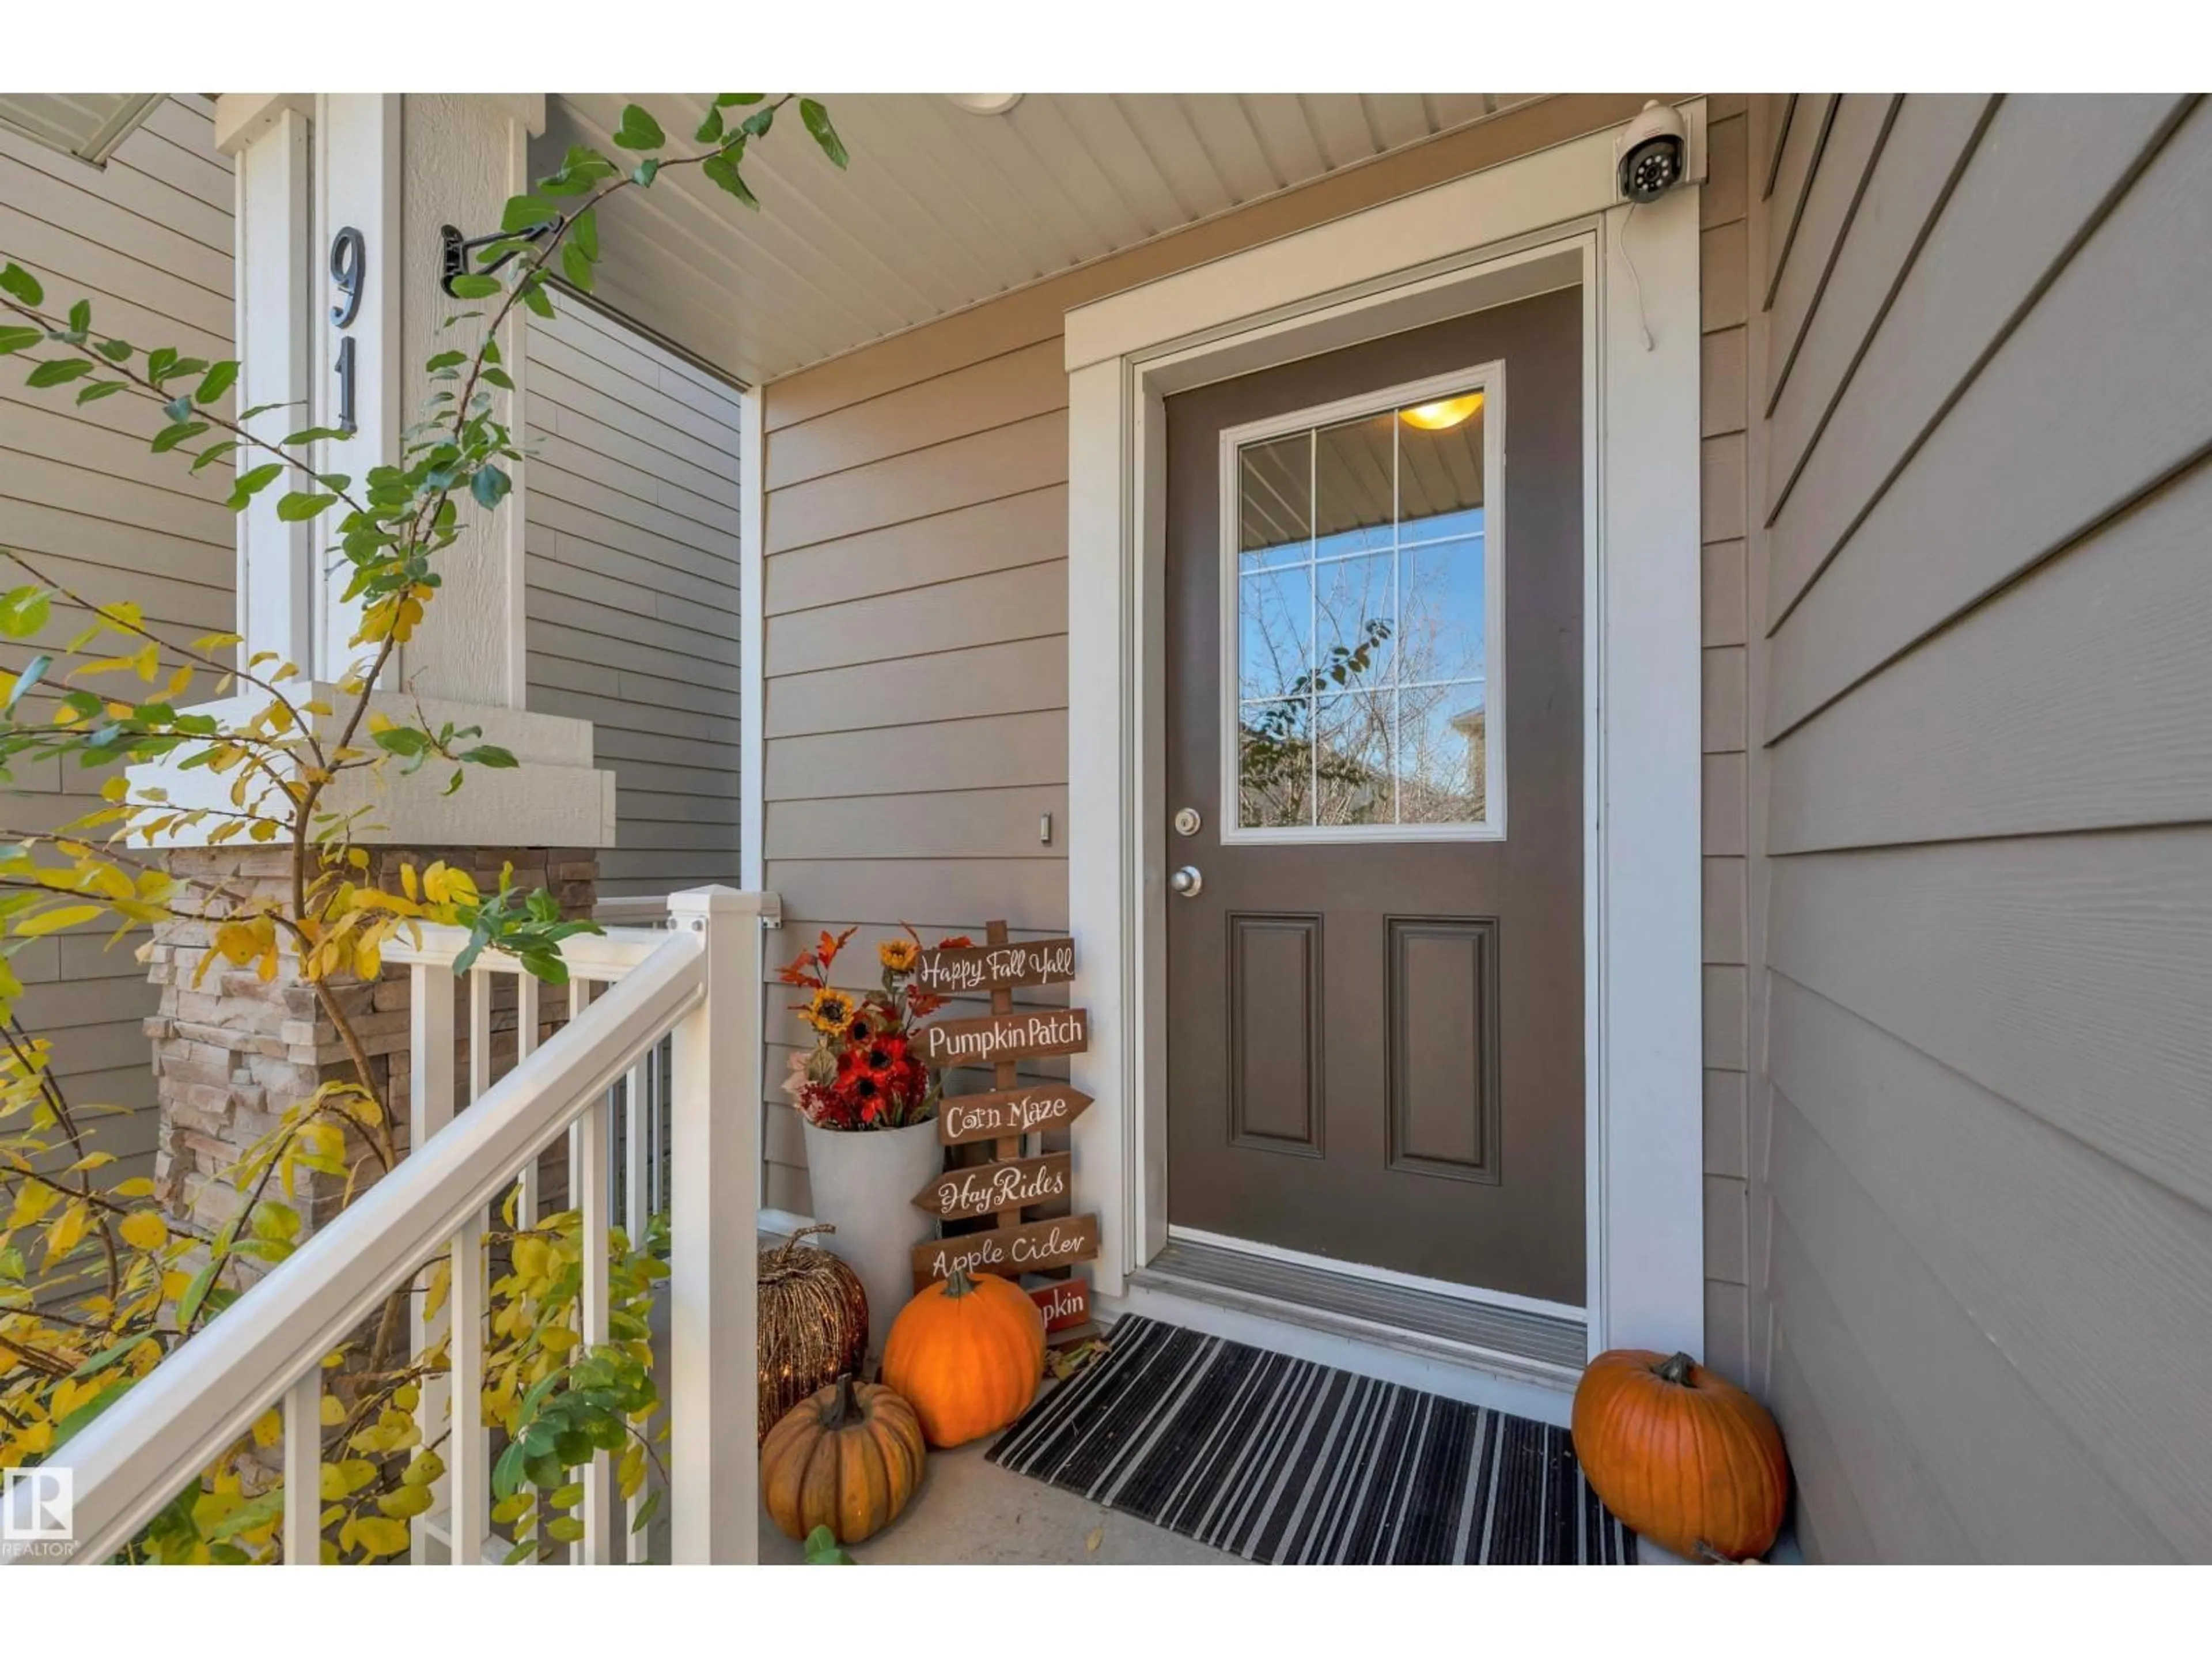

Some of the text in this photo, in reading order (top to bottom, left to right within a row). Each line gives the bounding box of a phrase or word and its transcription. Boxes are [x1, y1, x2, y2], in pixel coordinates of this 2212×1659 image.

[330, 226, 366, 433] 91
[921, 952, 986, 990] Happy
[986, 949, 1025, 979] Fall
[929, 1014, 1082, 1060] Pumpkin Patch
[946, 1096, 1068, 1138] Corn Maze
[938, 1165, 1064, 1214] Hay Rides
[933, 1226, 1085, 1278] Apple Cider
[1039, 1288, 1084, 1329] pkin
